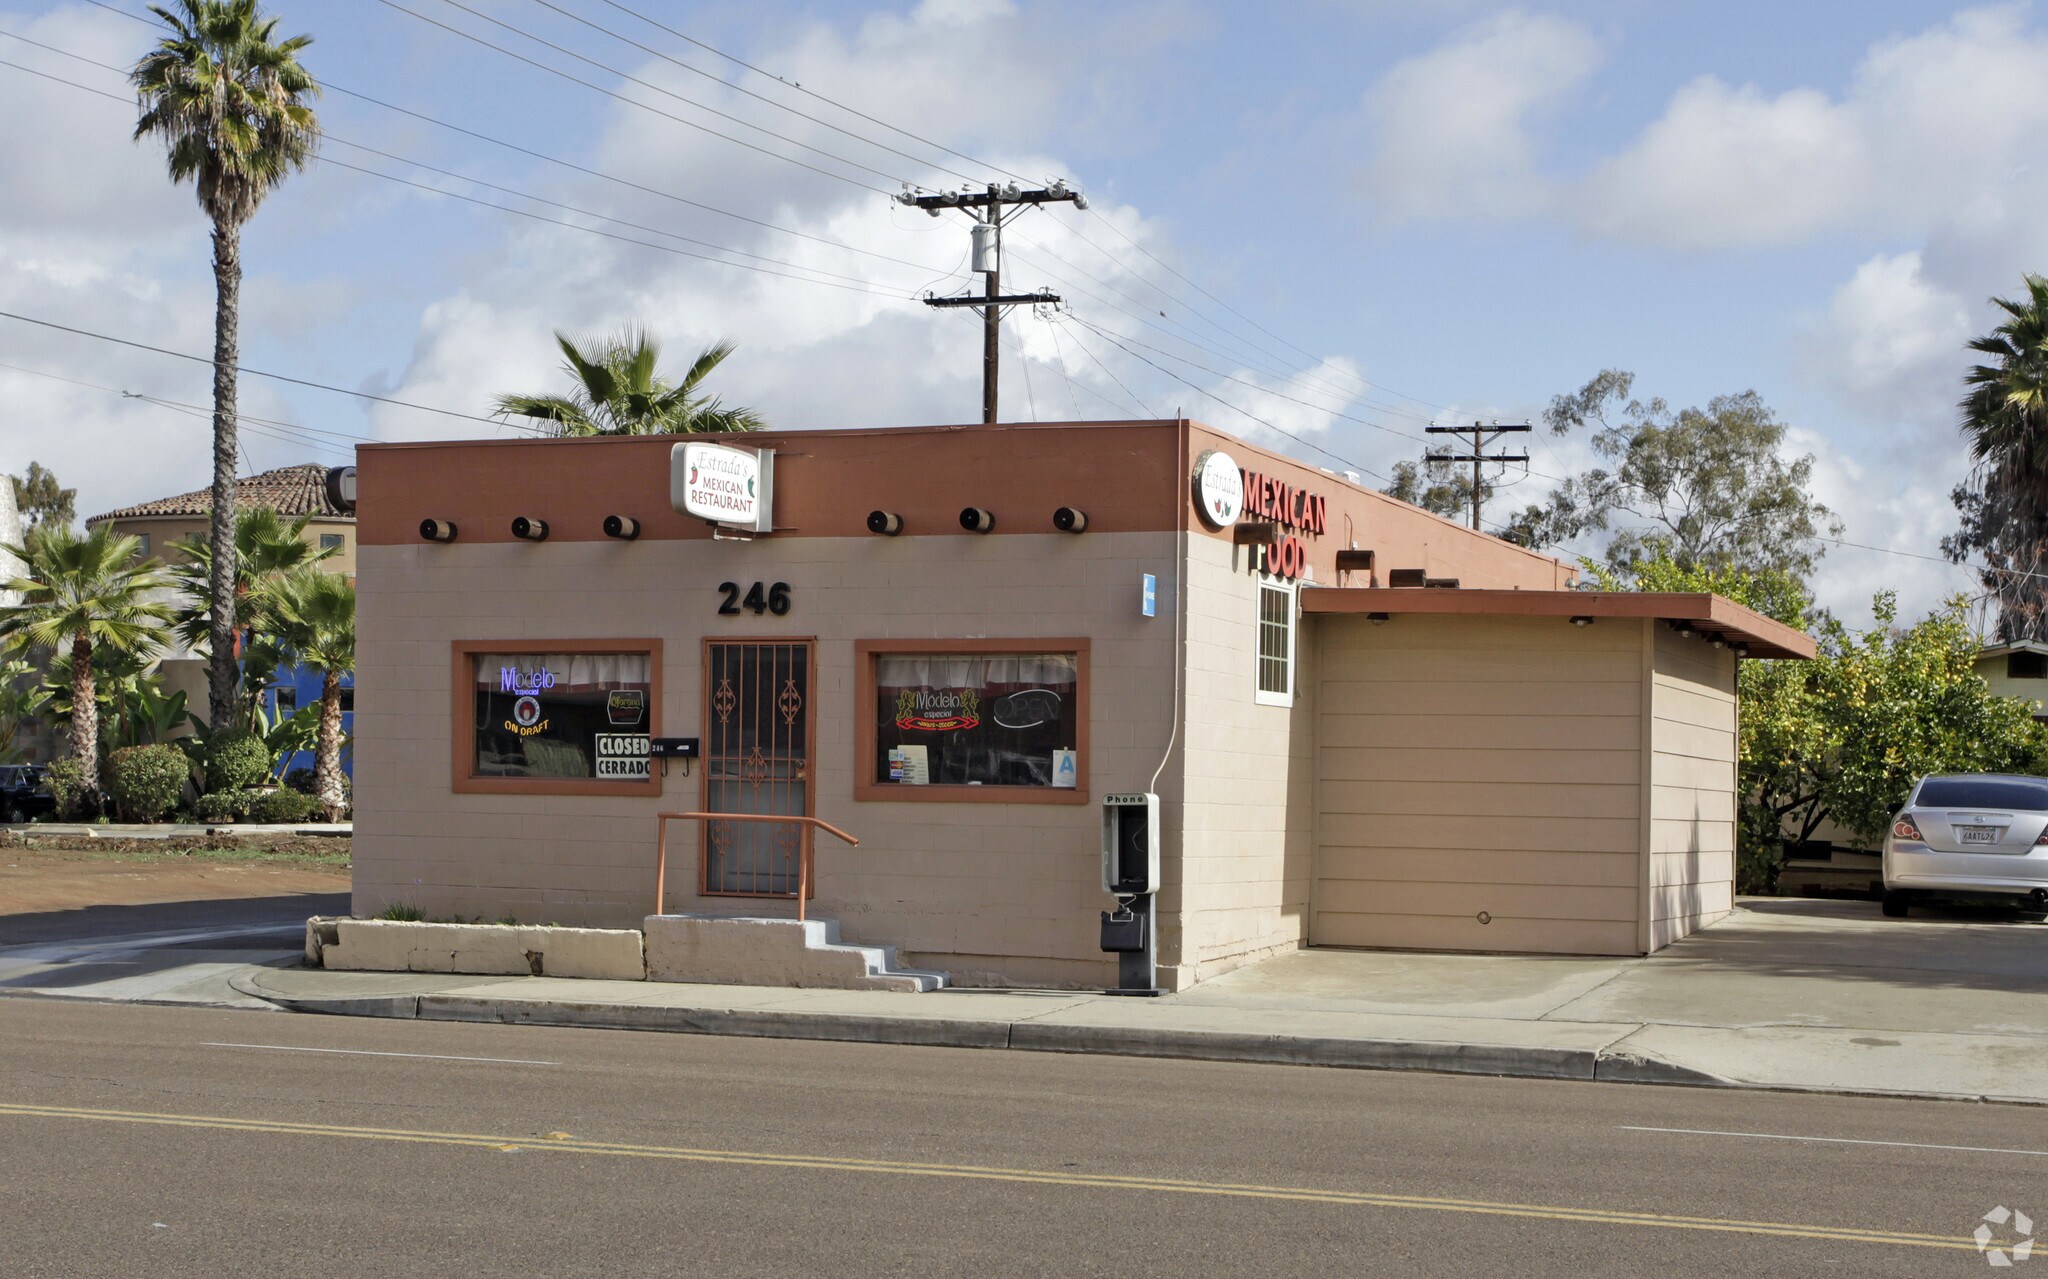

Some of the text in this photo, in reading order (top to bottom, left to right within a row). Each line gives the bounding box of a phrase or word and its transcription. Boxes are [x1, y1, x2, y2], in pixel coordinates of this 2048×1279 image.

[697, 452, 748, 477] Estrada's
[703, 476, 743, 495] MEXICAN
[1205, 464, 1243, 498] Estradas
[691, 490, 753, 513] RESTAURANT
[1243, 467, 1327, 535] MEXICAN
[717, 581, 792, 616] 246
[501, 666, 555, 692] Modelo
[916, 691, 960, 710] Modelo
[923, 711, 952, 719] especial
[504, 719, 549, 736] ON DRAFT
[599, 738, 650, 755] CLOSED
[1059, 753, 1075, 773] A
